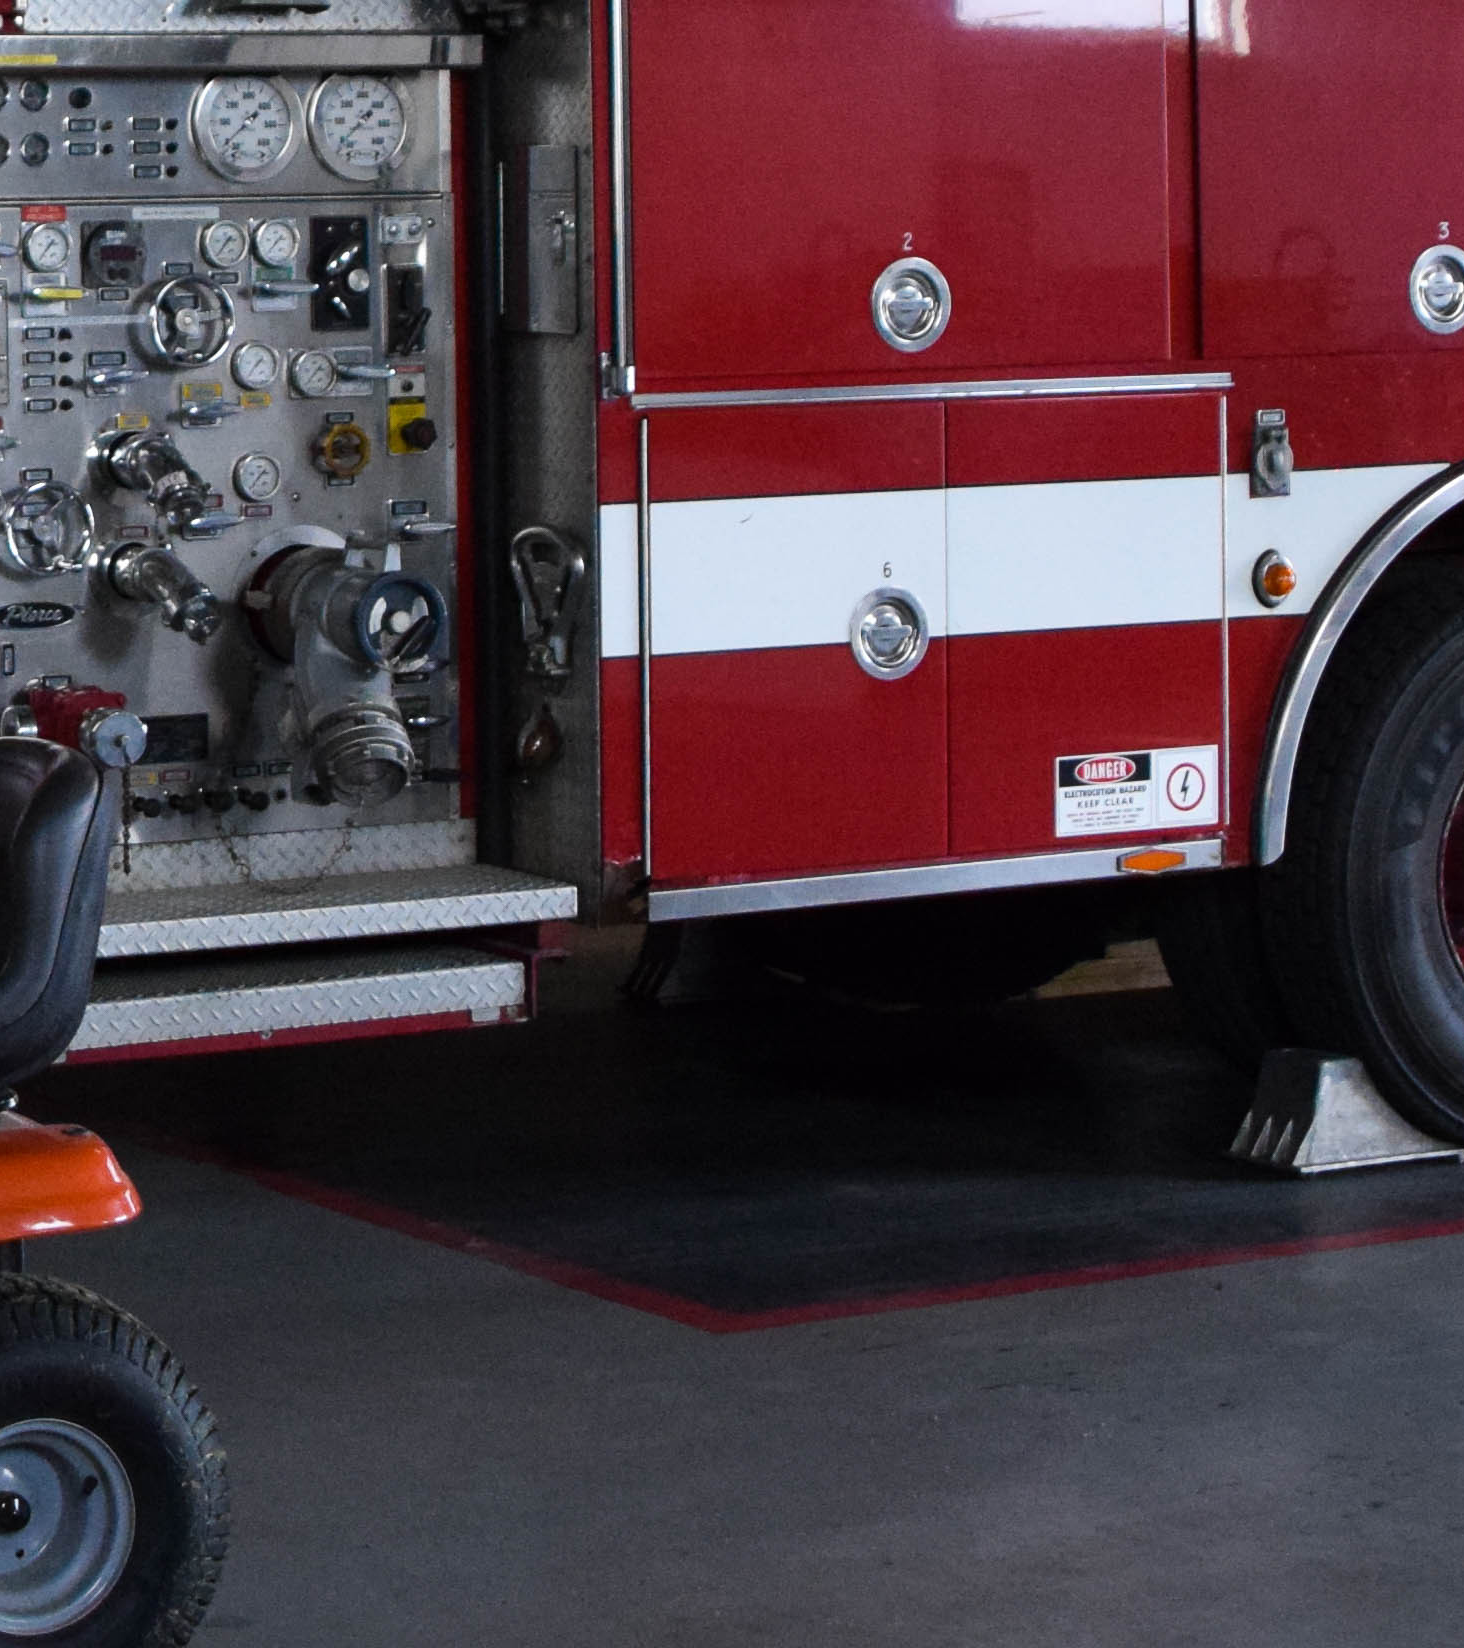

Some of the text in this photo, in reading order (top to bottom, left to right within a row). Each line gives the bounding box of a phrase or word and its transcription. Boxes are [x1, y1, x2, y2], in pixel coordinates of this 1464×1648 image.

[1439, 221, 1449, 239] 3
[903, 232, 913, 251] 2
[883, 562, 892, 578] 6
[1083, 760, 1128, 780] DANGER
[1077, 797, 1134, 809] KEEP CLEAR
